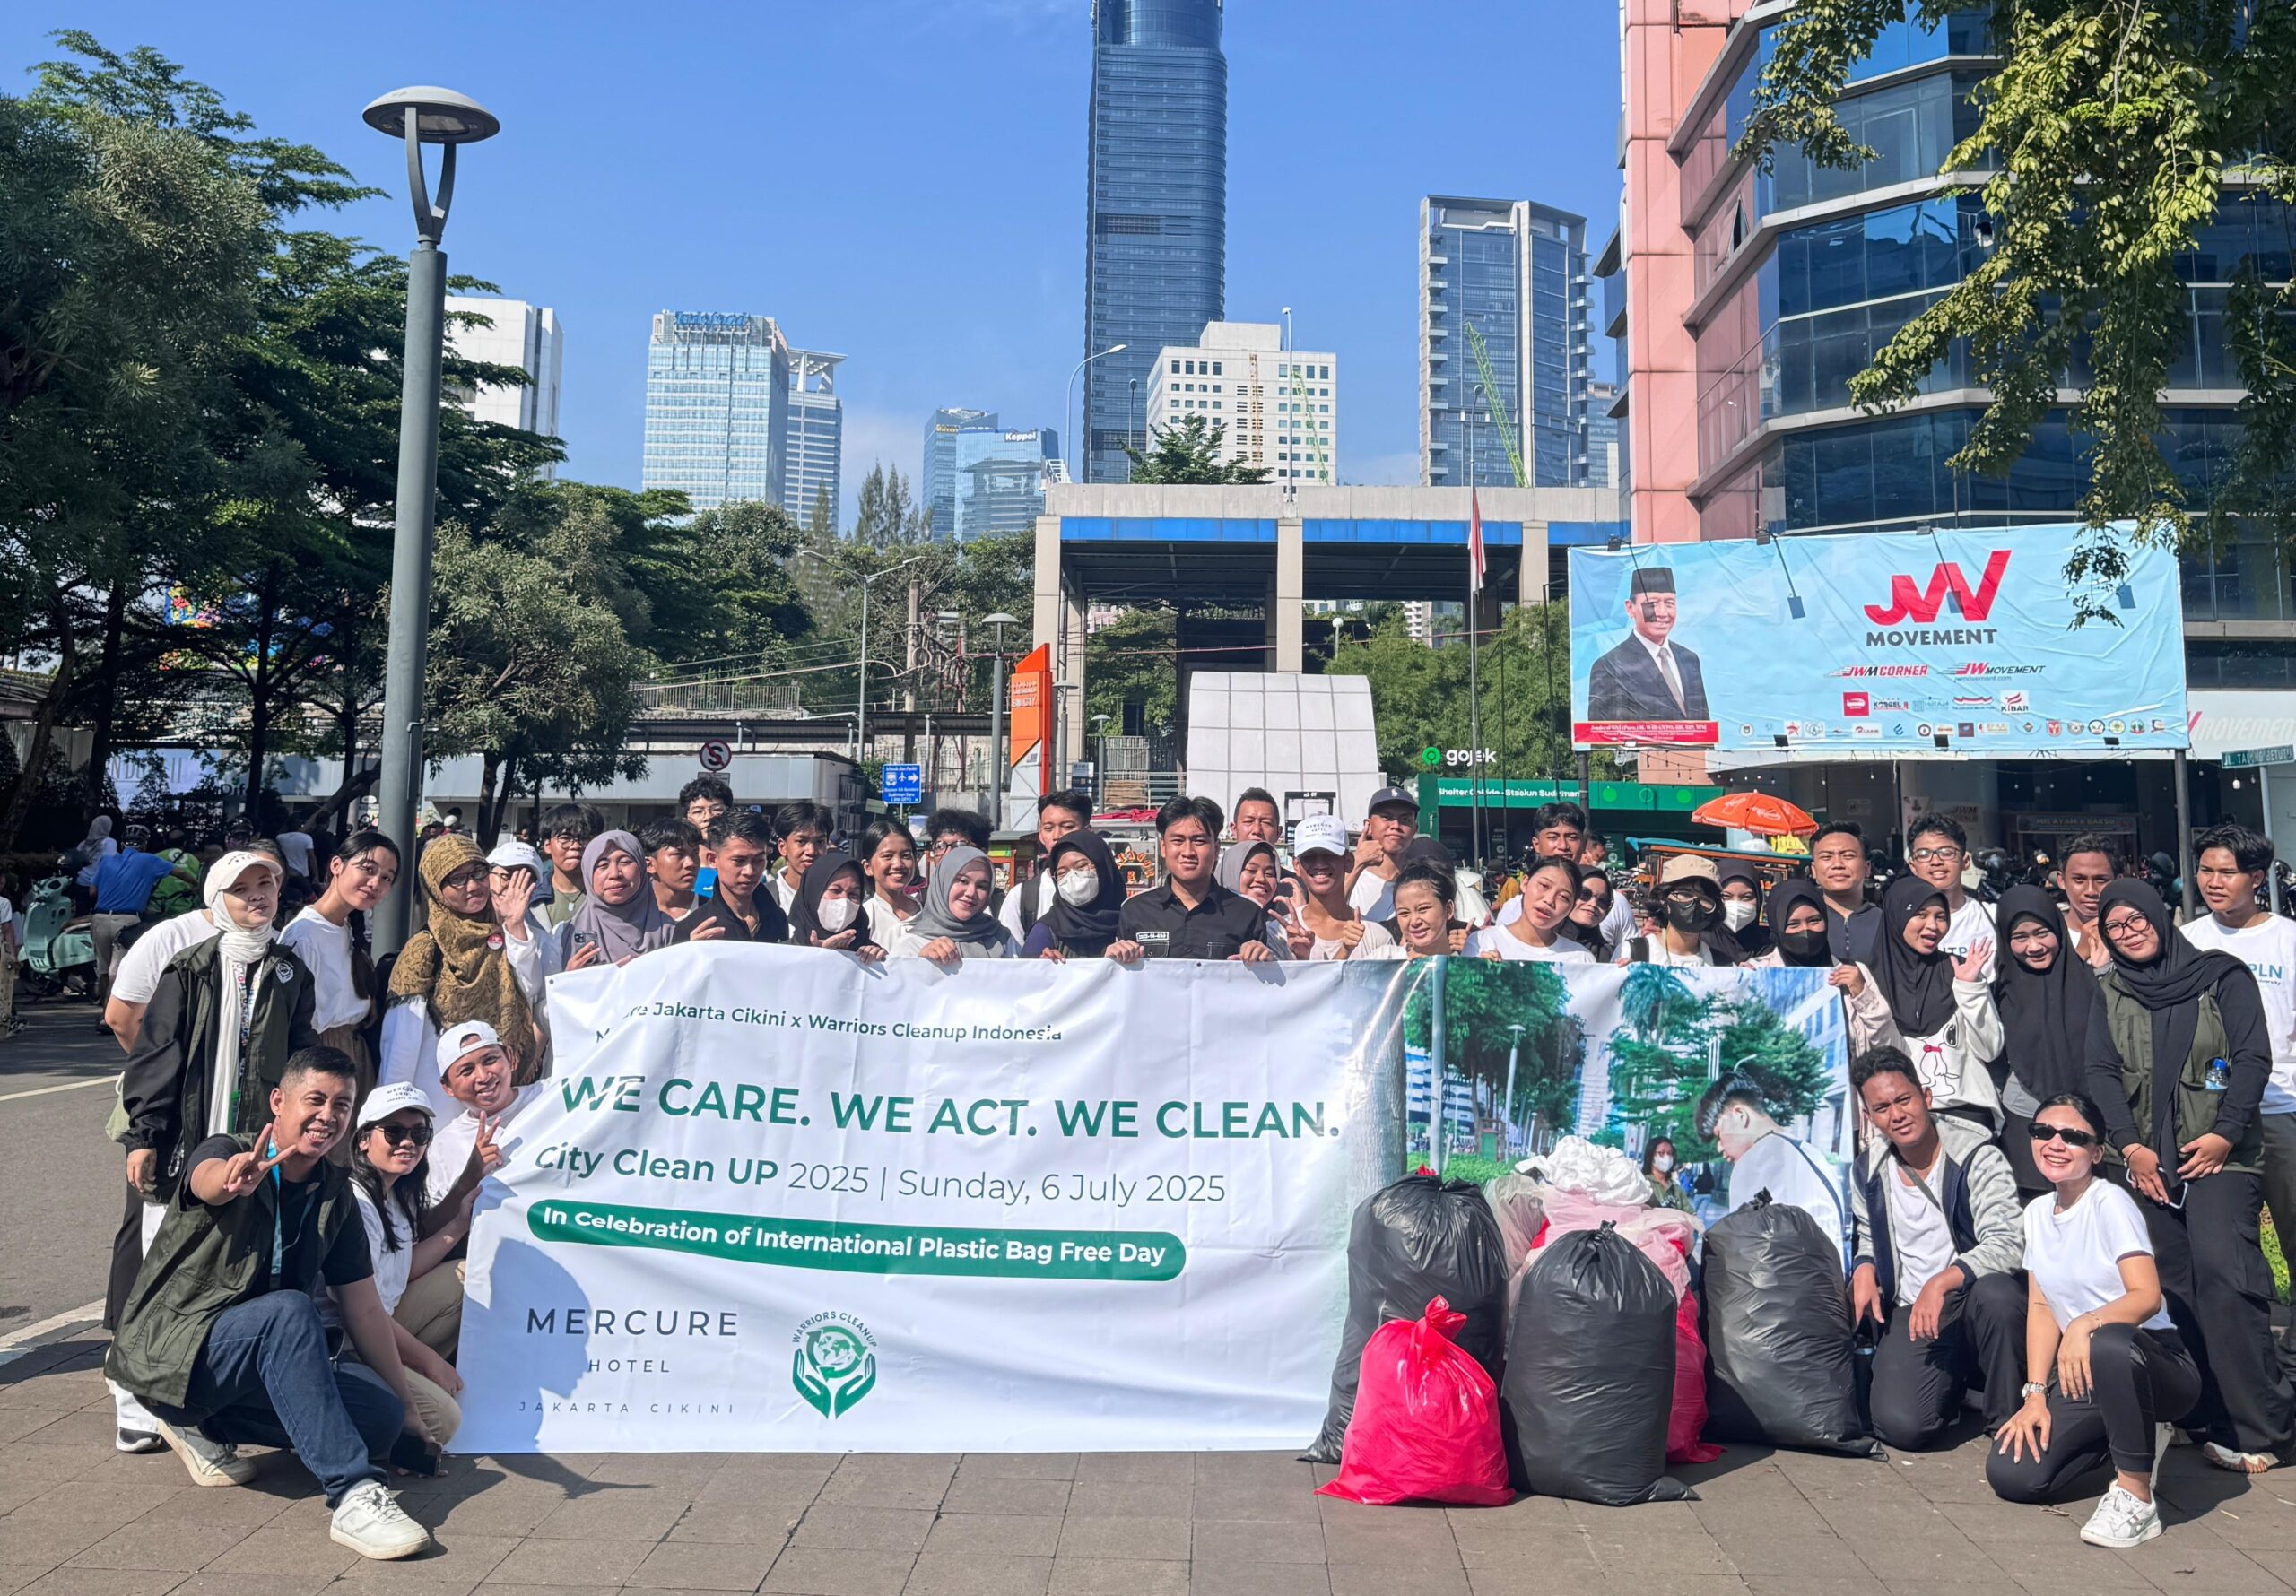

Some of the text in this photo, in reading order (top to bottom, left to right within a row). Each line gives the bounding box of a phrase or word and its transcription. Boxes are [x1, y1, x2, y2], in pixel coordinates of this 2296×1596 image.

[1005, 431, 1036, 441] Keppel
[1866, 629, 1998, 647] MOVEMENT
[2248, 963, 2283, 979] PLN
[652, 1002, 1062, 1043] Jakarta Cikini x Warriors Cleanup Indonesia
[561, 1076, 1341, 1139] WE CARE. WE ACT. WE CLEAN.
[535, 1141, 604, 1179] City
[613, 1148, 715, 1183] Clean
[727, 1157, 778, 1186] UP
[787, 1162, 869, 1193] 2025
[898, 1169, 1030, 1207] Sunday,
[1040, 1174, 1062, 1202] 6
[1069, 1174, 1137, 1208] July
[1145, 1175, 1227, 1202] 2025
[544, 1206, 1167, 1267] In Celebration of International Plastic Bag Free Day
[526, 1307, 739, 1337] MERCURE
[791, 1311, 878, 1348] WARRIORS CLEANUP
[588, 1358, 671, 1374] HOTEL
[518, 1401, 735, 1414] JAKARTA CIKINI
